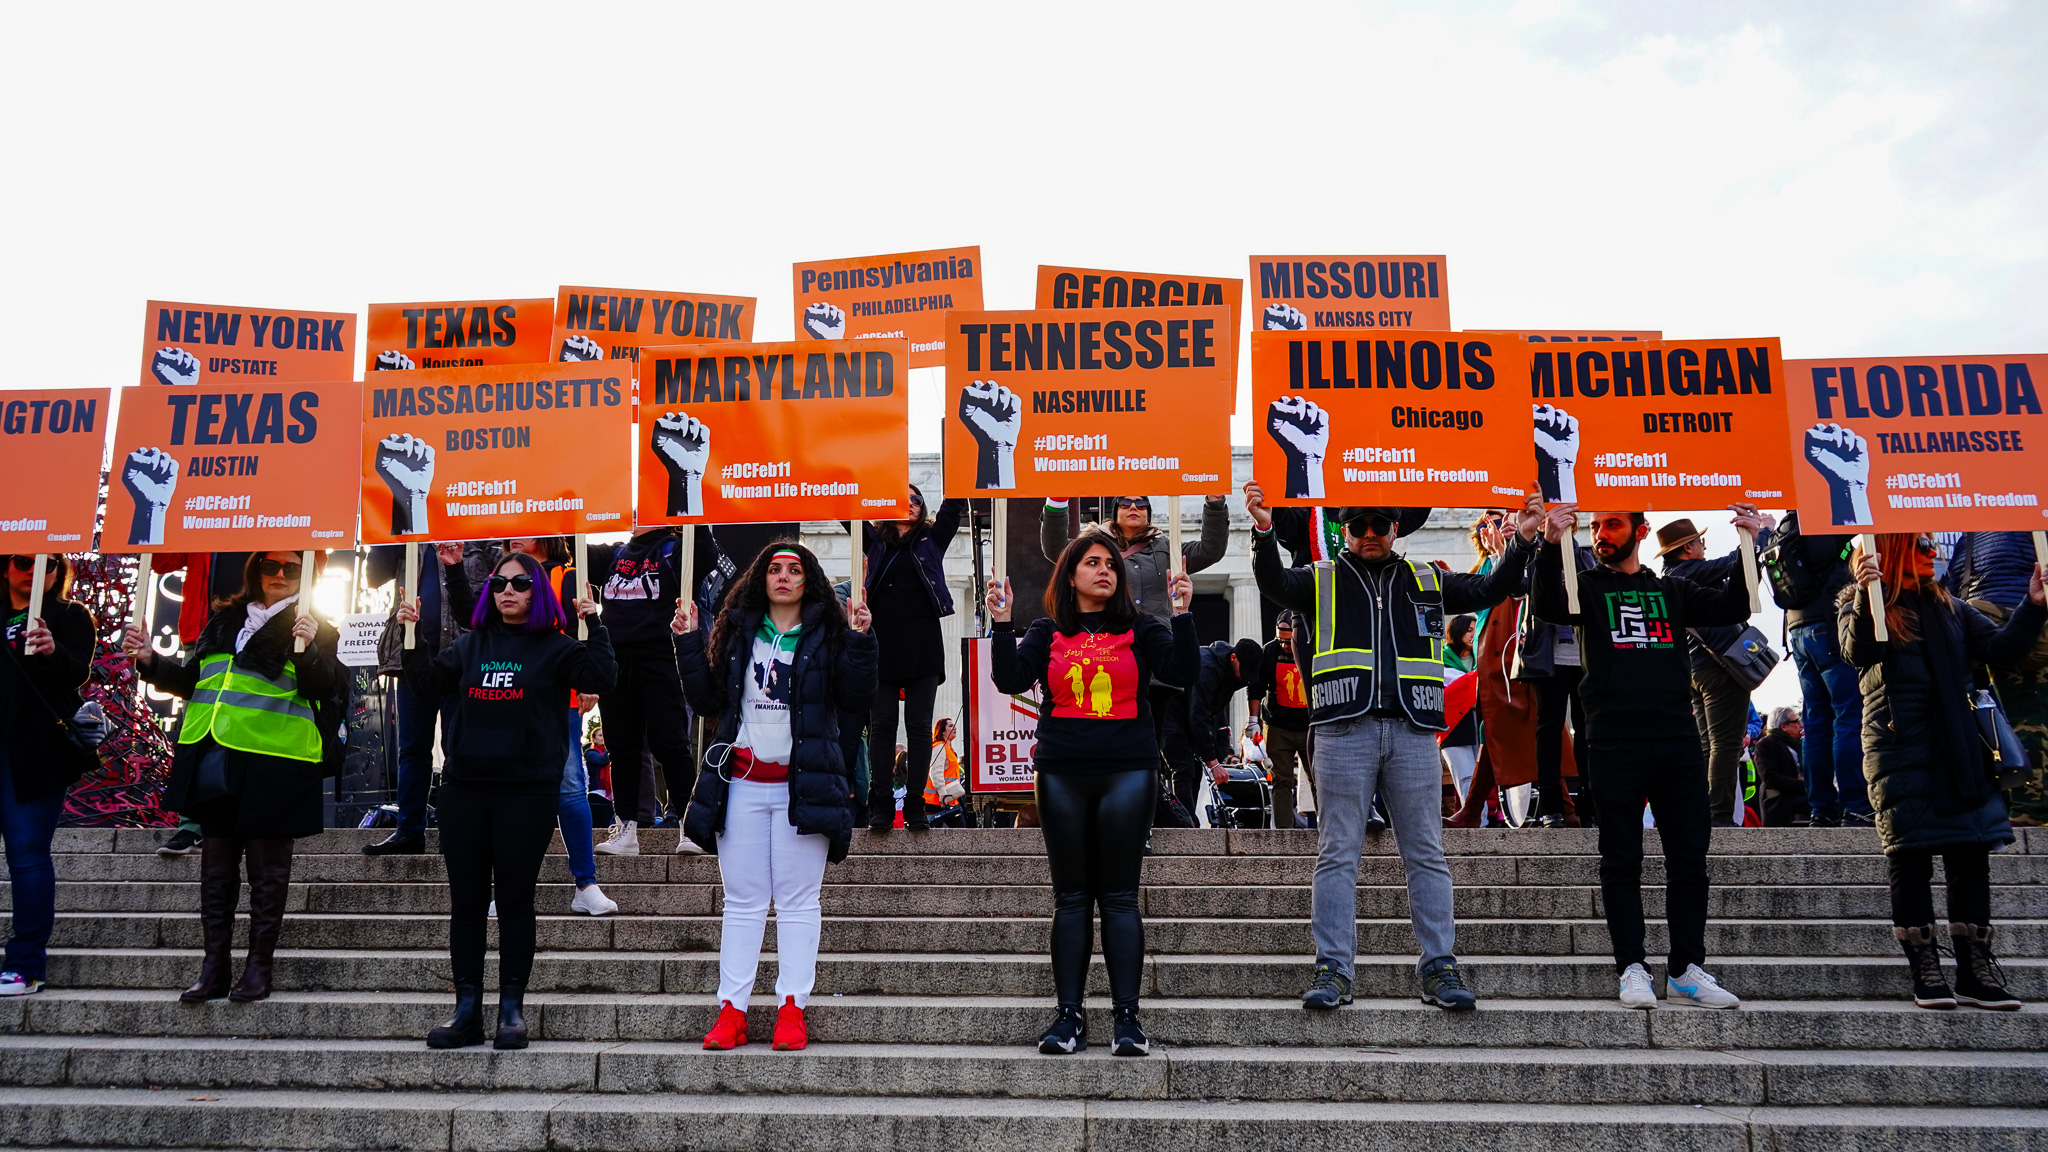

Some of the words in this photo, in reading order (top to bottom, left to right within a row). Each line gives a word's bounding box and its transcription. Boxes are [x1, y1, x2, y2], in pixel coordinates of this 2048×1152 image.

[801, 256, 973, 293] Pennsylvania
[1259, 261, 1440, 299] MISSOURI
[1053, 272, 1223, 309] GEORGIA
[852, 294, 953, 317] PHILADELPHIA
[566, 294, 644, 333] NEW
[651, 297, 744, 340] YORK
[1314, 311, 1375, 328] KANSAS
[1378, 311, 1413, 327] CITY
[157, 308, 242, 346] NEW
[250, 314, 345, 352] YORK
[402, 306, 517, 349] TEXAS
[911, 341, 945, 352] Freedo
[960, 319, 1215, 372] TENNESSEE
[208, 357, 278, 376] UPSTATE
[422, 357, 483, 369] Houston
[1288, 340, 1496, 391] ILLINOIS
[1529, 346, 1772, 398] MICHIGAN
[655, 351, 895, 405] MARYLAND
[372, 377, 622, 418] MASSACHUSETTS
[1811, 363, 2044, 419] FLORIDA
[1032, 389, 1146, 414] NASHVILLE
[0, 399, 97, 435] GTON
[167, 391, 319, 446] TEXAS
[1391, 406, 1484, 431] Chicago
[1643, 411, 1733, 434] DETROIT
[445, 426, 530, 452] BOSTON
[1034, 434, 1107, 451] #DCFeb11
[1876, 430, 2024, 454] TALLAHASSEE
[1034, 457, 1087, 472] Woman
[1090, 456, 1115, 471] Life
[1117, 455, 1179, 471] Freedom
[1342, 447, 1416, 463] #DCFeb11
[1593, 452, 1667, 468] #DCFeb11
[187, 455, 259, 477] AUSTIN
[721, 461, 791, 479] #DCFeb11
[1343, 468, 1397, 482] Woman
[1399, 468, 1425, 482] Life
[1427, 468, 1489, 482] Freedom
[446, 479, 517, 497] #DCFeb11
[1594, 472, 1649, 487] Woman
[1651, 472, 1676, 487] Life
[1679, 472, 1742, 487] Freedom
[1885, 472, 1961, 489] #DCFeb11
[720, 484, 771, 499] Woman
[774, 482, 798, 497] Life
[800, 481, 859, 497] Freedom
[184, 495, 251, 511] #DCFeb11
[446, 501, 498, 517] Woman
[500, 500, 523, 515] Life
[526, 497, 583, 513] Freedom
[1888, 494, 1944, 509] Woman
[1945, 493, 1972, 508] Life
[1973, 492, 2038, 507] Freedom
[182, 515, 230, 529] Woman
[231, 514, 255, 528] Life
[256, 514, 311, 528] Freedom
[481, 660, 522, 672] WOMAN
[482, 672, 514, 688] LIFE
[468, 687, 523, 700] FREEDOM
[993, 729, 1034, 741] HOW
[988, 765, 1006, 776] IS
